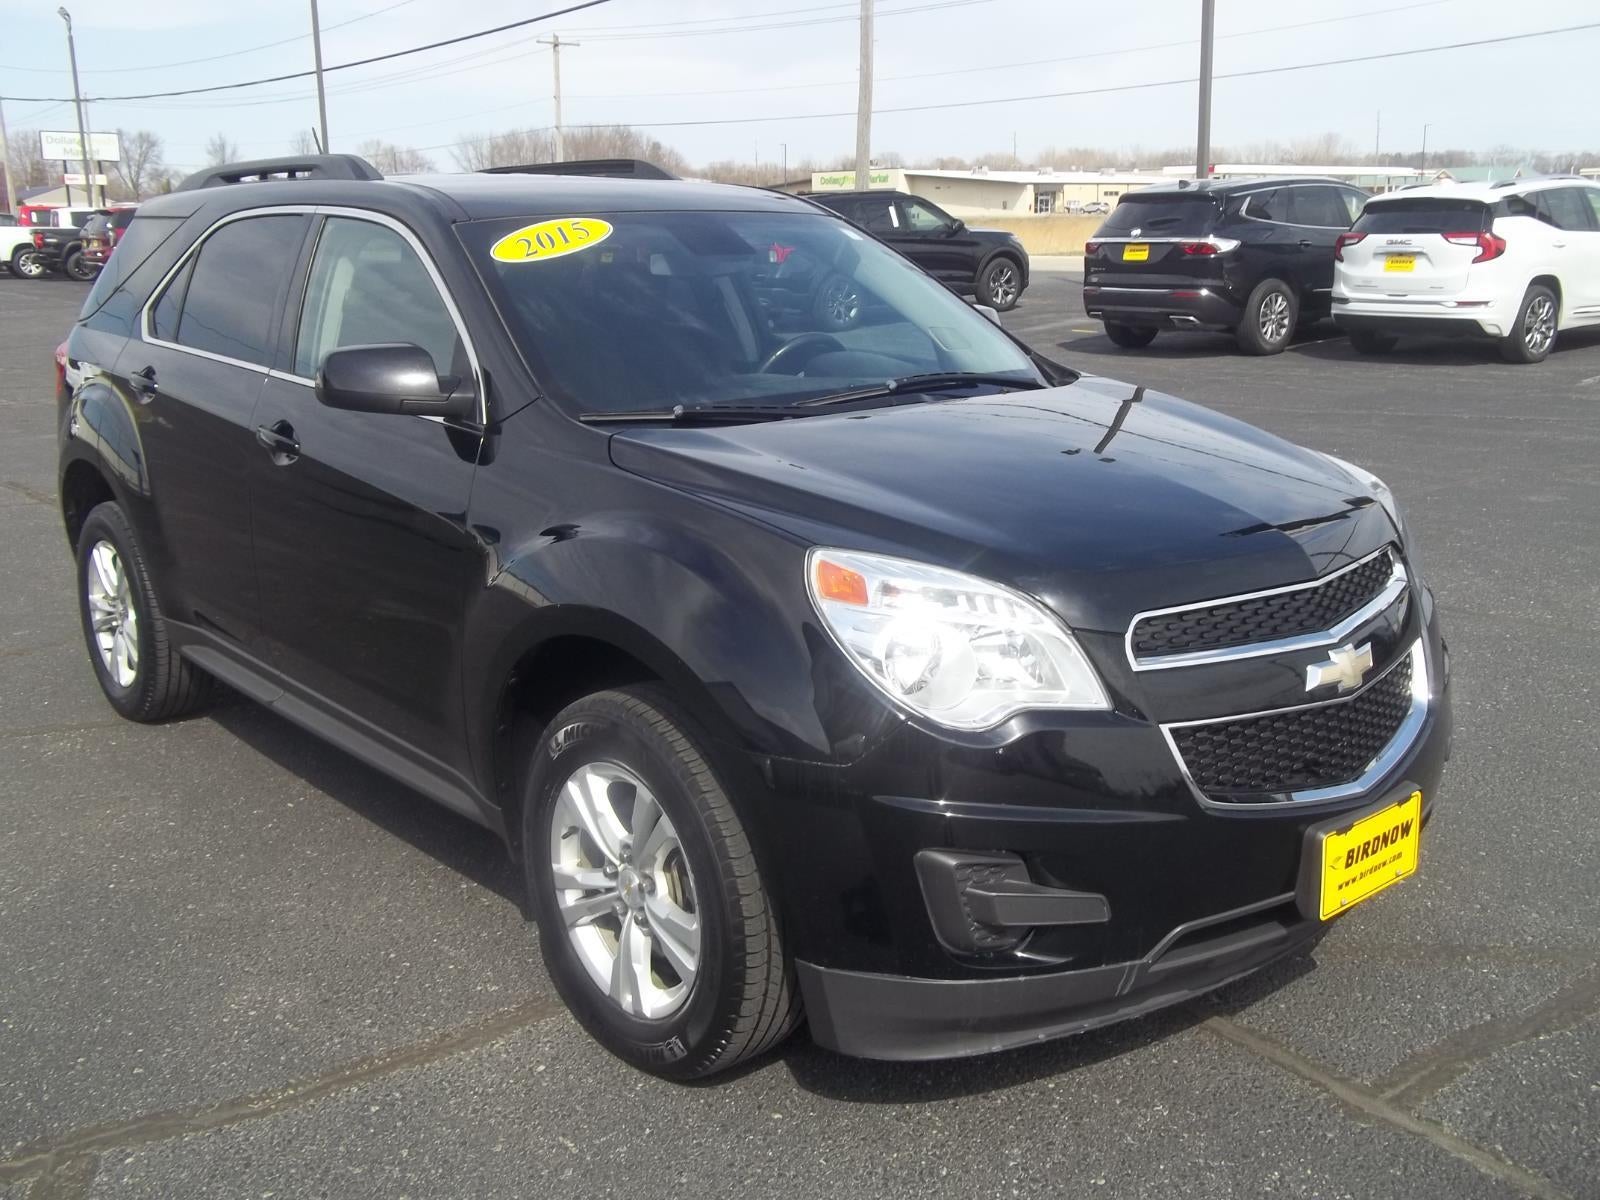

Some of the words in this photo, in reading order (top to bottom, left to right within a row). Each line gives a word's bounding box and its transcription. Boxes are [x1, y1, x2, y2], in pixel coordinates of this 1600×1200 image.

[516, 222, 590, 257] 2015
[1344, 817, 1414, 869] BIRDNOW
[1337, 851, 1403, 891] www.birdnow.com
